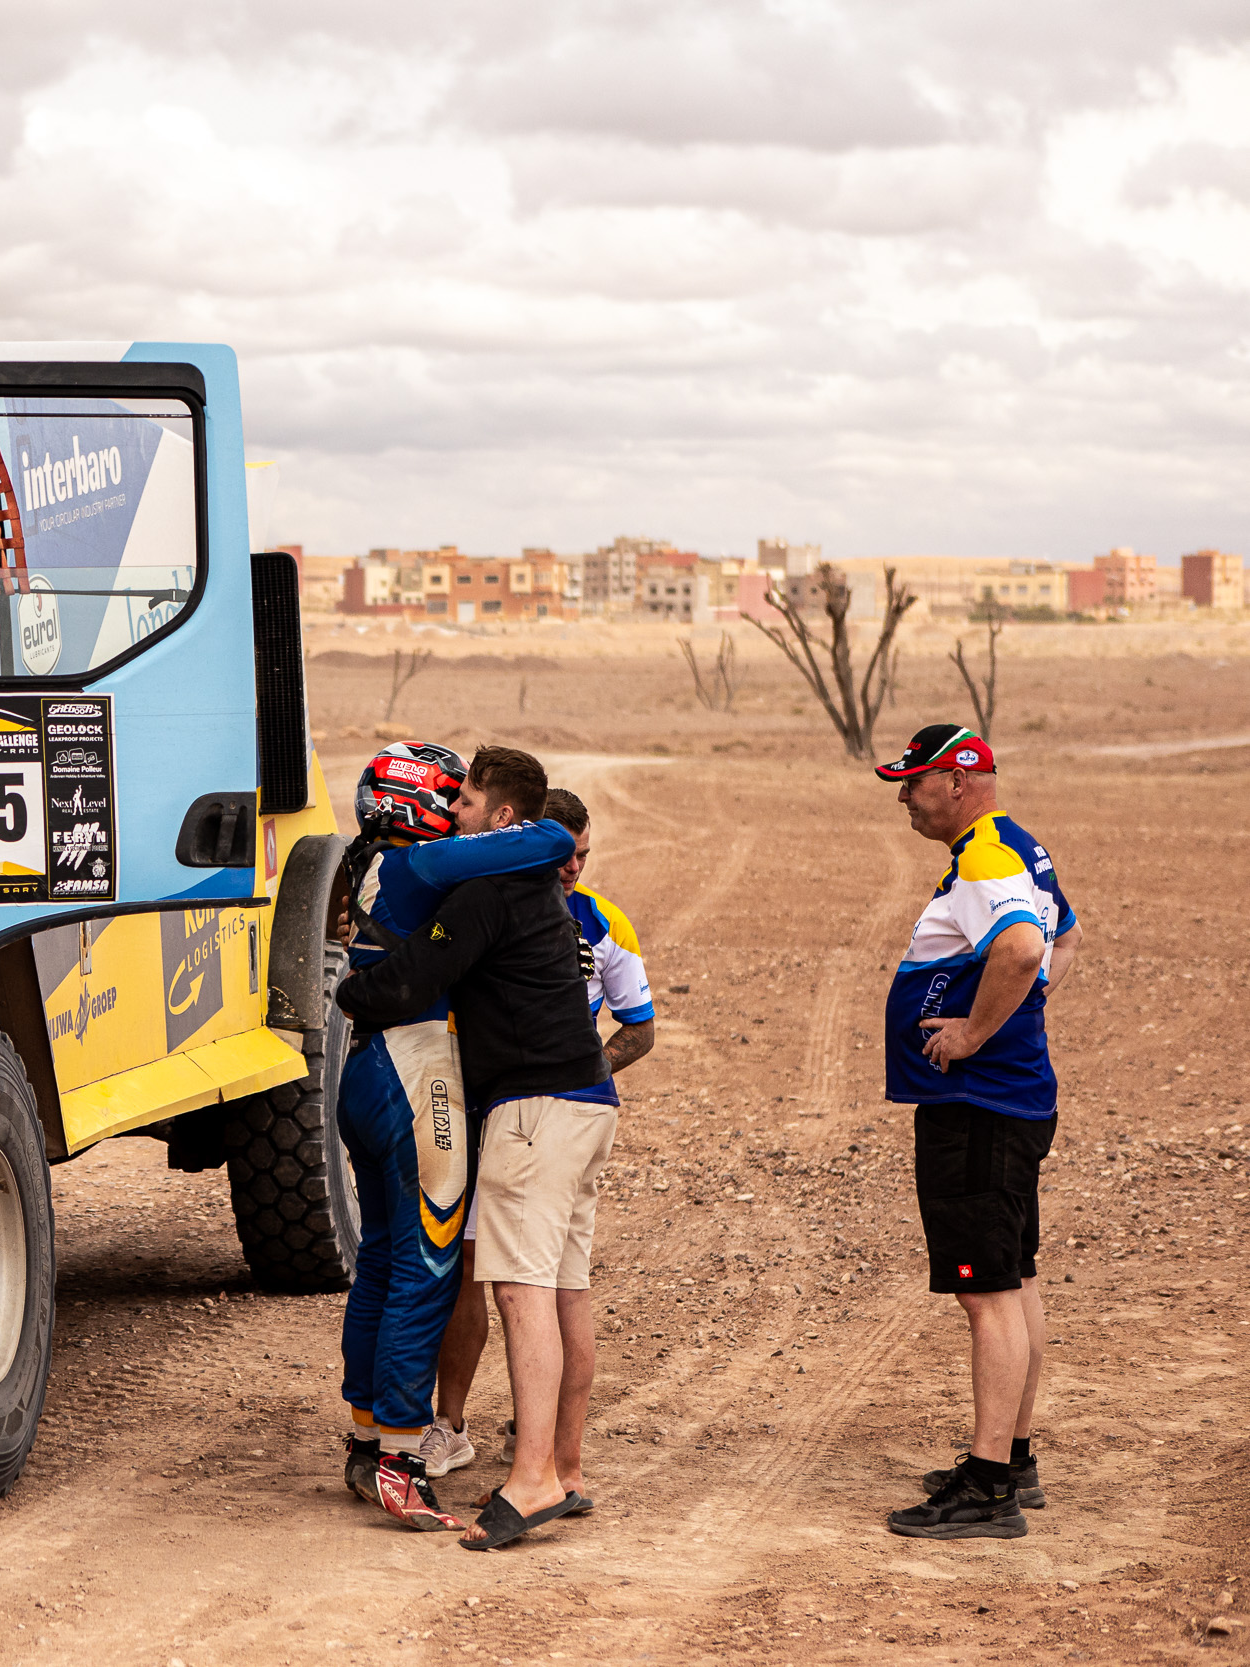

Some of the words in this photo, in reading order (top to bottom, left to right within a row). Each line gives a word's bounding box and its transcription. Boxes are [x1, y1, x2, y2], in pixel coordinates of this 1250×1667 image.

[22, 435, 122, 512] interbaro
[39, 516, 54, 532] YOUR
[55, 508, 80, 528] CIRCULAR
[81, 501, 104, 519] INDUSTRY
[104, 493, 127, 511] PARTNER
[23, 609, 58, 650] eurol
[30, 645, 55, 660] LUBRICANTS
[48, 725, 103, 734] GEOLOCK
[51, 798, 73, 808] Next
[83, 798, 106, 808] Level
[53, 831, 106, 844] FERYN
[186, 913, 246, 973] LOGISTICS
[91, 986, 117, 1020] GROEP
[431, 1080, 452, 1151] #KJHD
[382, 1482, 405, 1506] sparco
